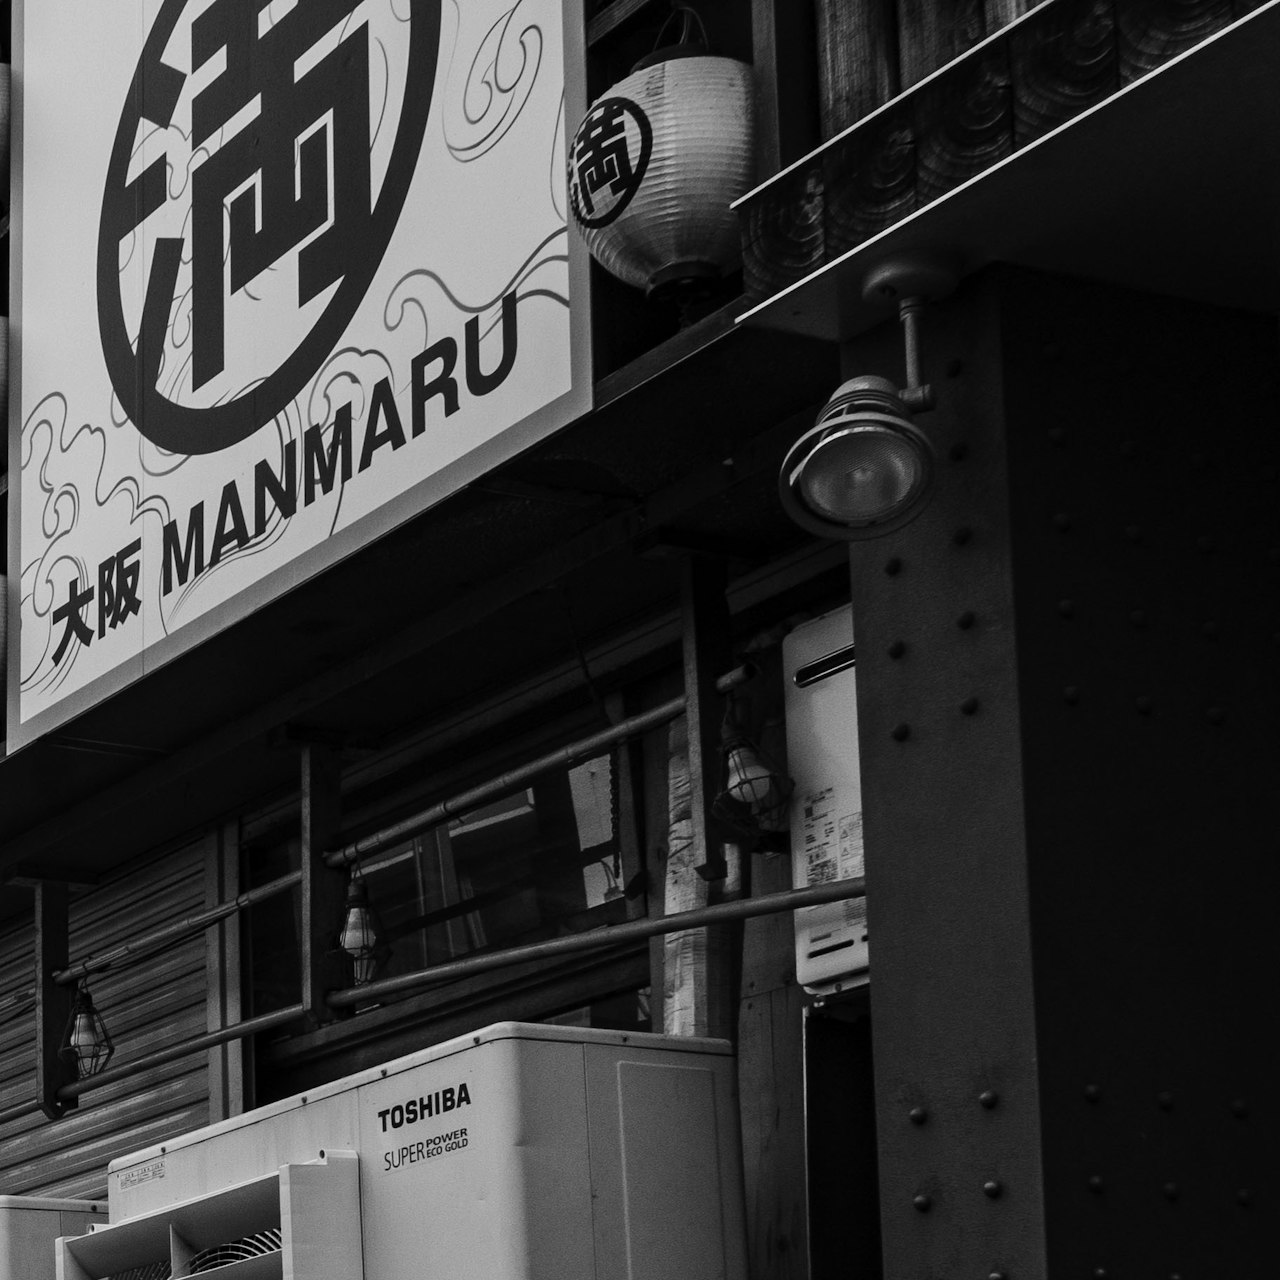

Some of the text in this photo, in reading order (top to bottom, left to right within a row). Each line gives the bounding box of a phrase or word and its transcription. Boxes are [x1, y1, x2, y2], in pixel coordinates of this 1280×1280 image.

[50, 292, 519, 667] 大阪 MANMARU
[377, 1082, 471, 1133] TOSHIBA
[383, 1128, 468, 1172] SUPER POWER
[425, 1137, 469, 1159] ECO GOLD
